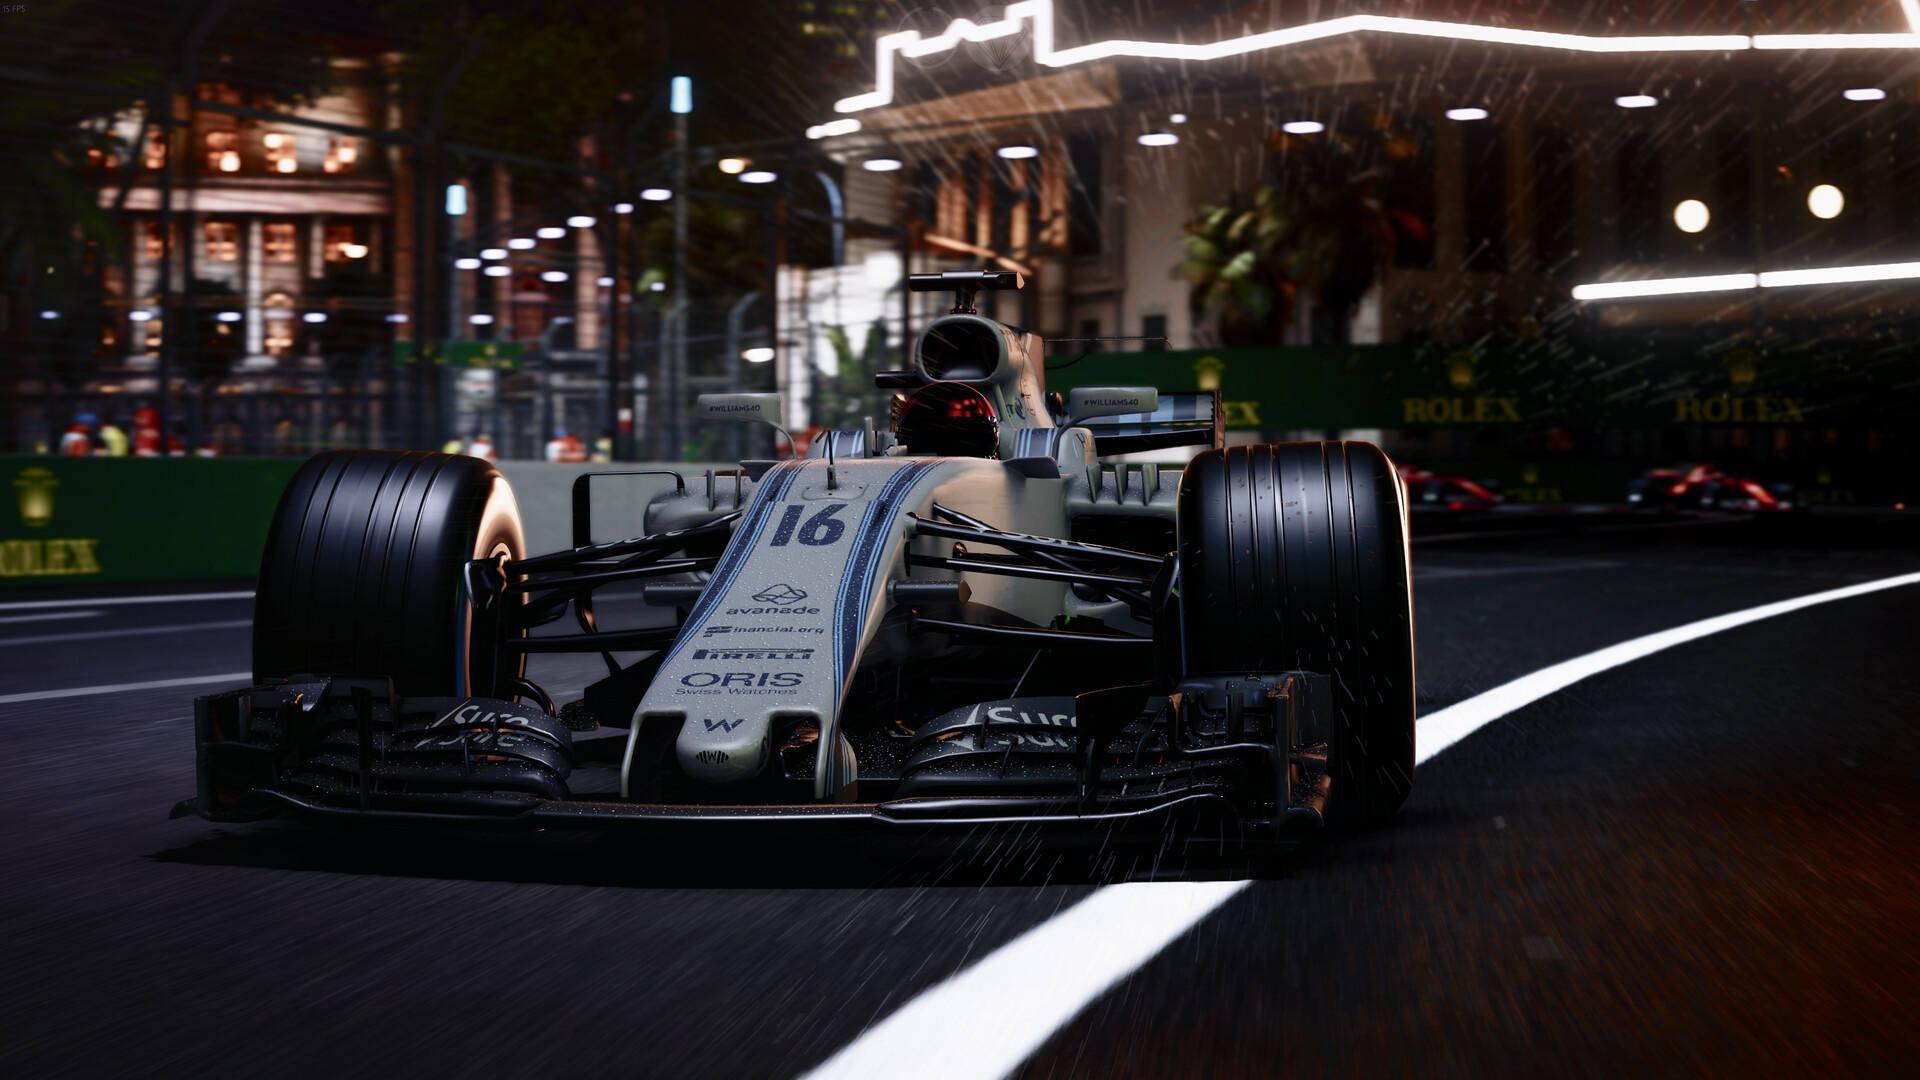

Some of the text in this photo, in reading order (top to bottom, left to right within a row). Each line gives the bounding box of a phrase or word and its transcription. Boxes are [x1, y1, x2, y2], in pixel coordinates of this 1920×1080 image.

[709, 404, 761, 412] #WILLIAMS40
[1402, 396, 1522, 424] ROLEX
[1673, 396, 1806, 424] ROLEX
[770, 504, 848, 546] 16
[0, 538, 103, 577] OLEX
[726, 606, 821, 615] avanade
[692, 648, 815, 660] PIRELLI
[681, 672, 804, 687] ORIS
[675, 688, 798, 696] Swiss Watches
